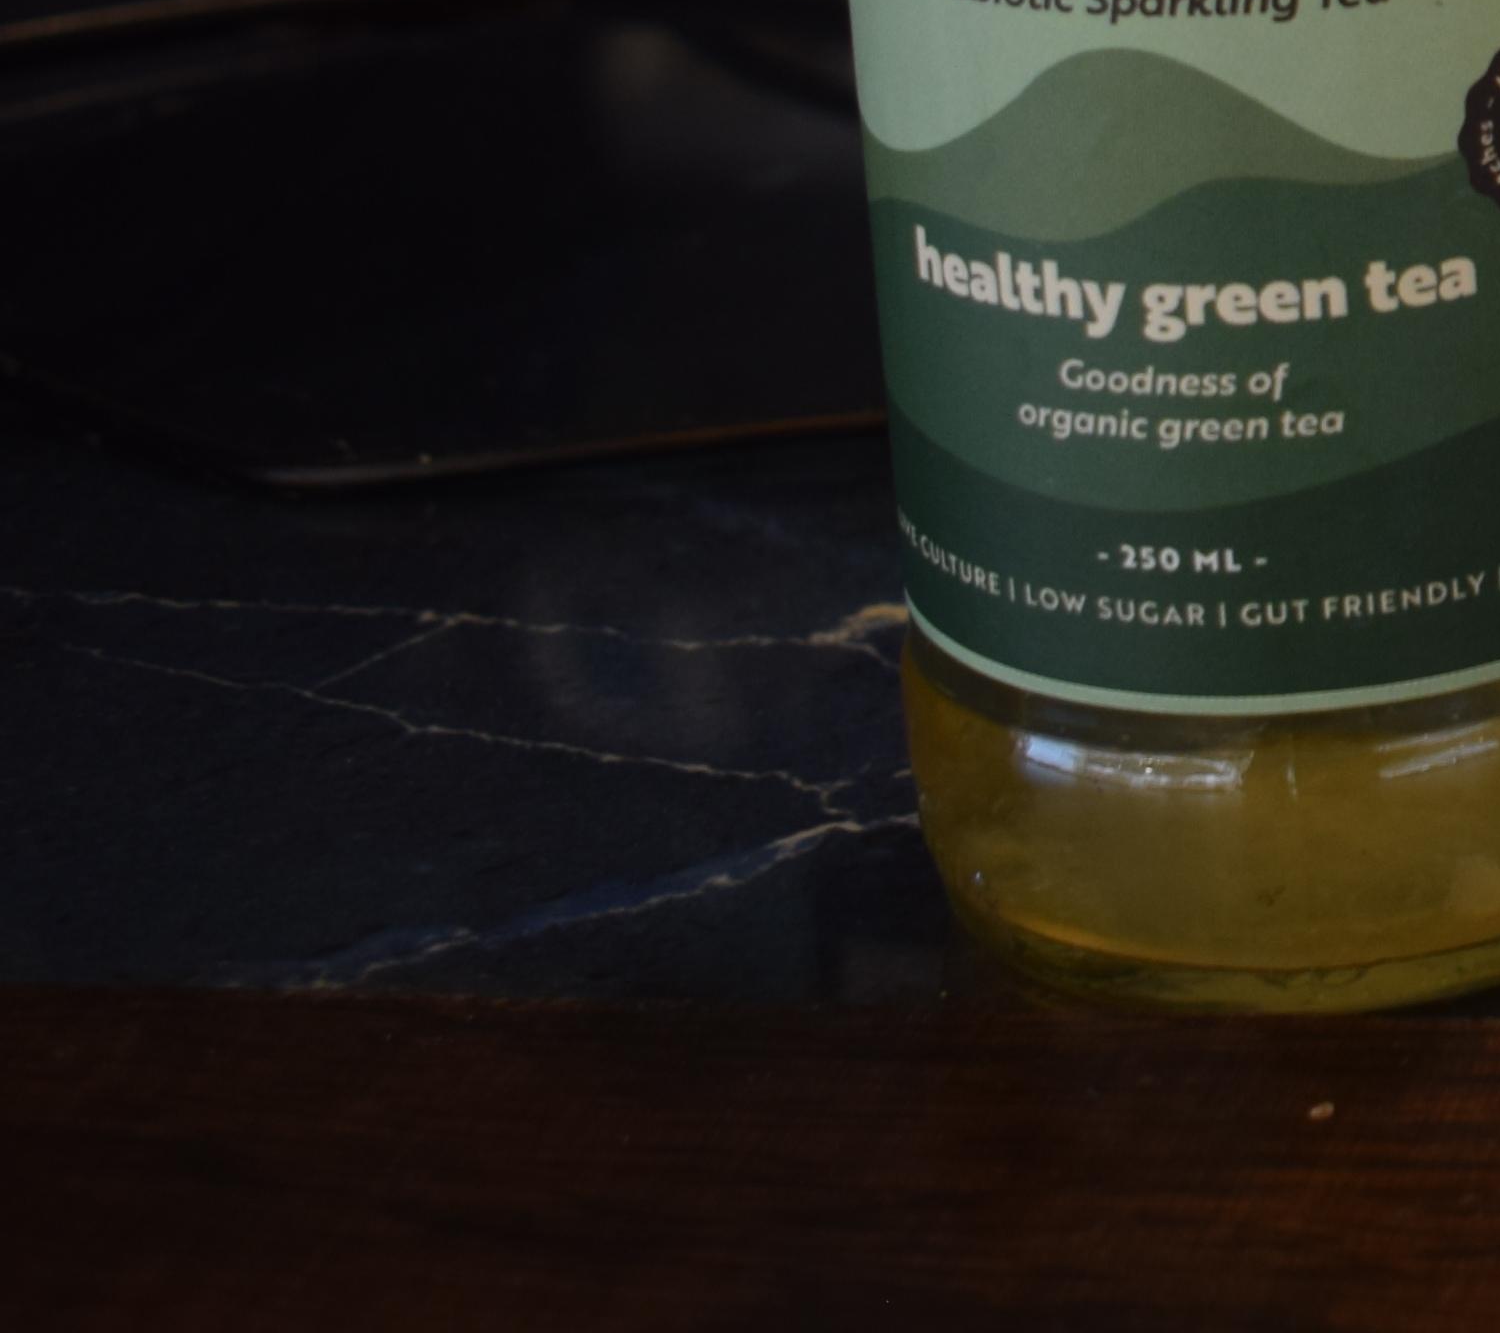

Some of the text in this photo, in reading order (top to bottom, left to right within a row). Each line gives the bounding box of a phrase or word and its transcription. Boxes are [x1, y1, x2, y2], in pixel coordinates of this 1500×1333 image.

[914, 225, 1477, 342] healthy green tea
[1059, 358, 1287, 401] Goodness of
[1018, 401, 1344, 449] organic green tea
[919, 534, 999, 595] CULTURE
[1025, 586, 1086, 615] LOW
[1098, 597, 1204, 625] SUGAR
[1241, 597, 1309, 626] GUT
[1323, 572, 1485, 620] FRIENDLY
[1121, 544, 1242, 572] 250 ML
